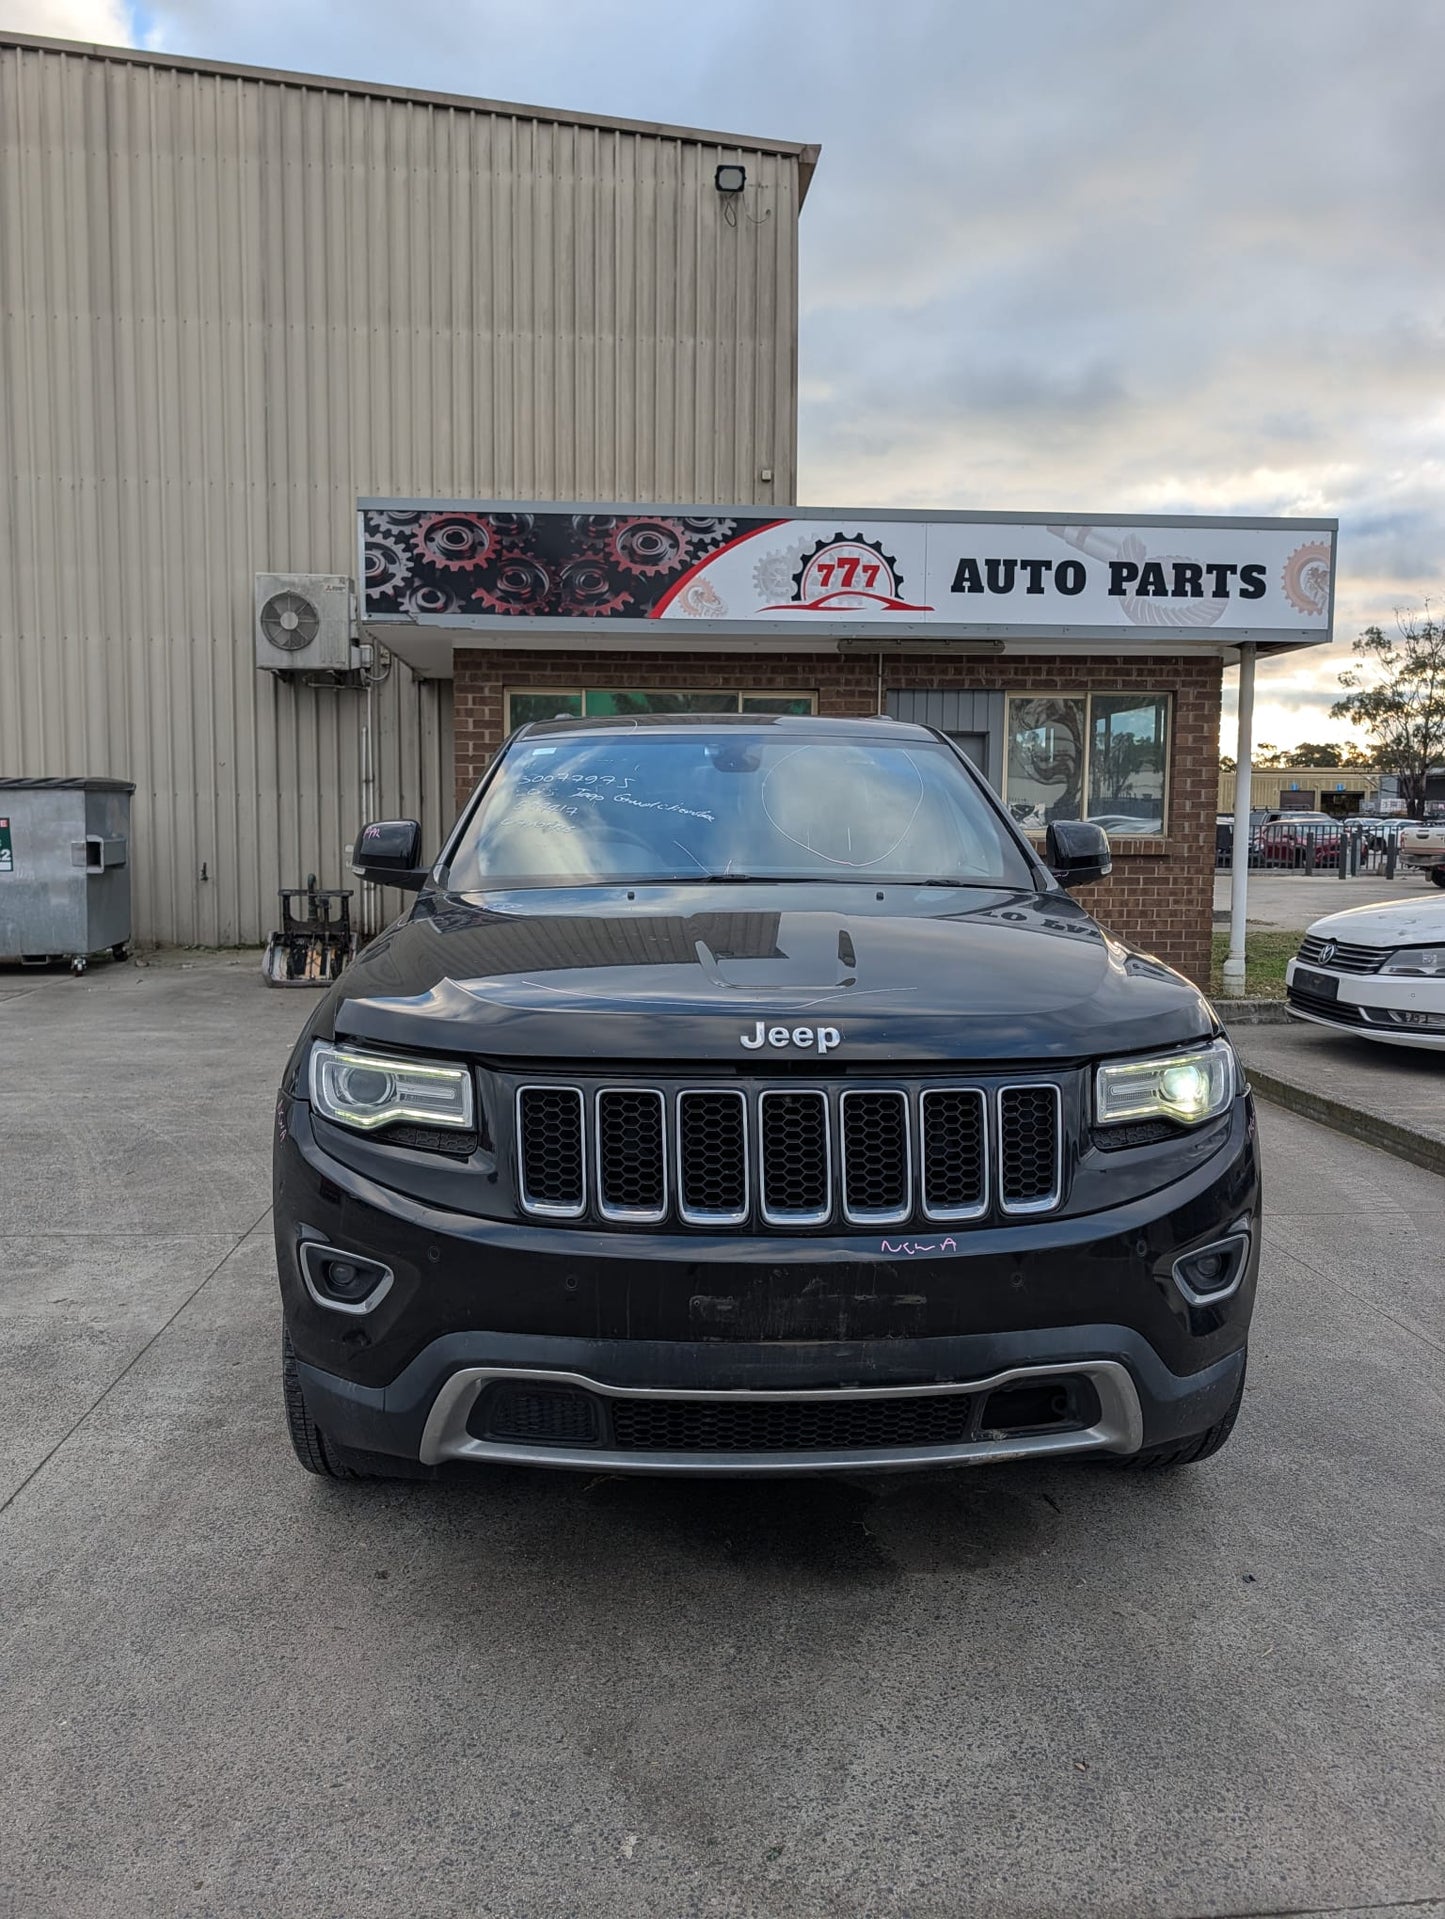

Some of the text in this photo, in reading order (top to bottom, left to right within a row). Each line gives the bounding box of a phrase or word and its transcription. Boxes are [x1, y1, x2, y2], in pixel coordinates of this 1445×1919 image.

[817, 557, 880, 588] 777
[950, 557, 1267, 600] AUTO PARTS
[740, 1021, 841, 1054] Jeep
